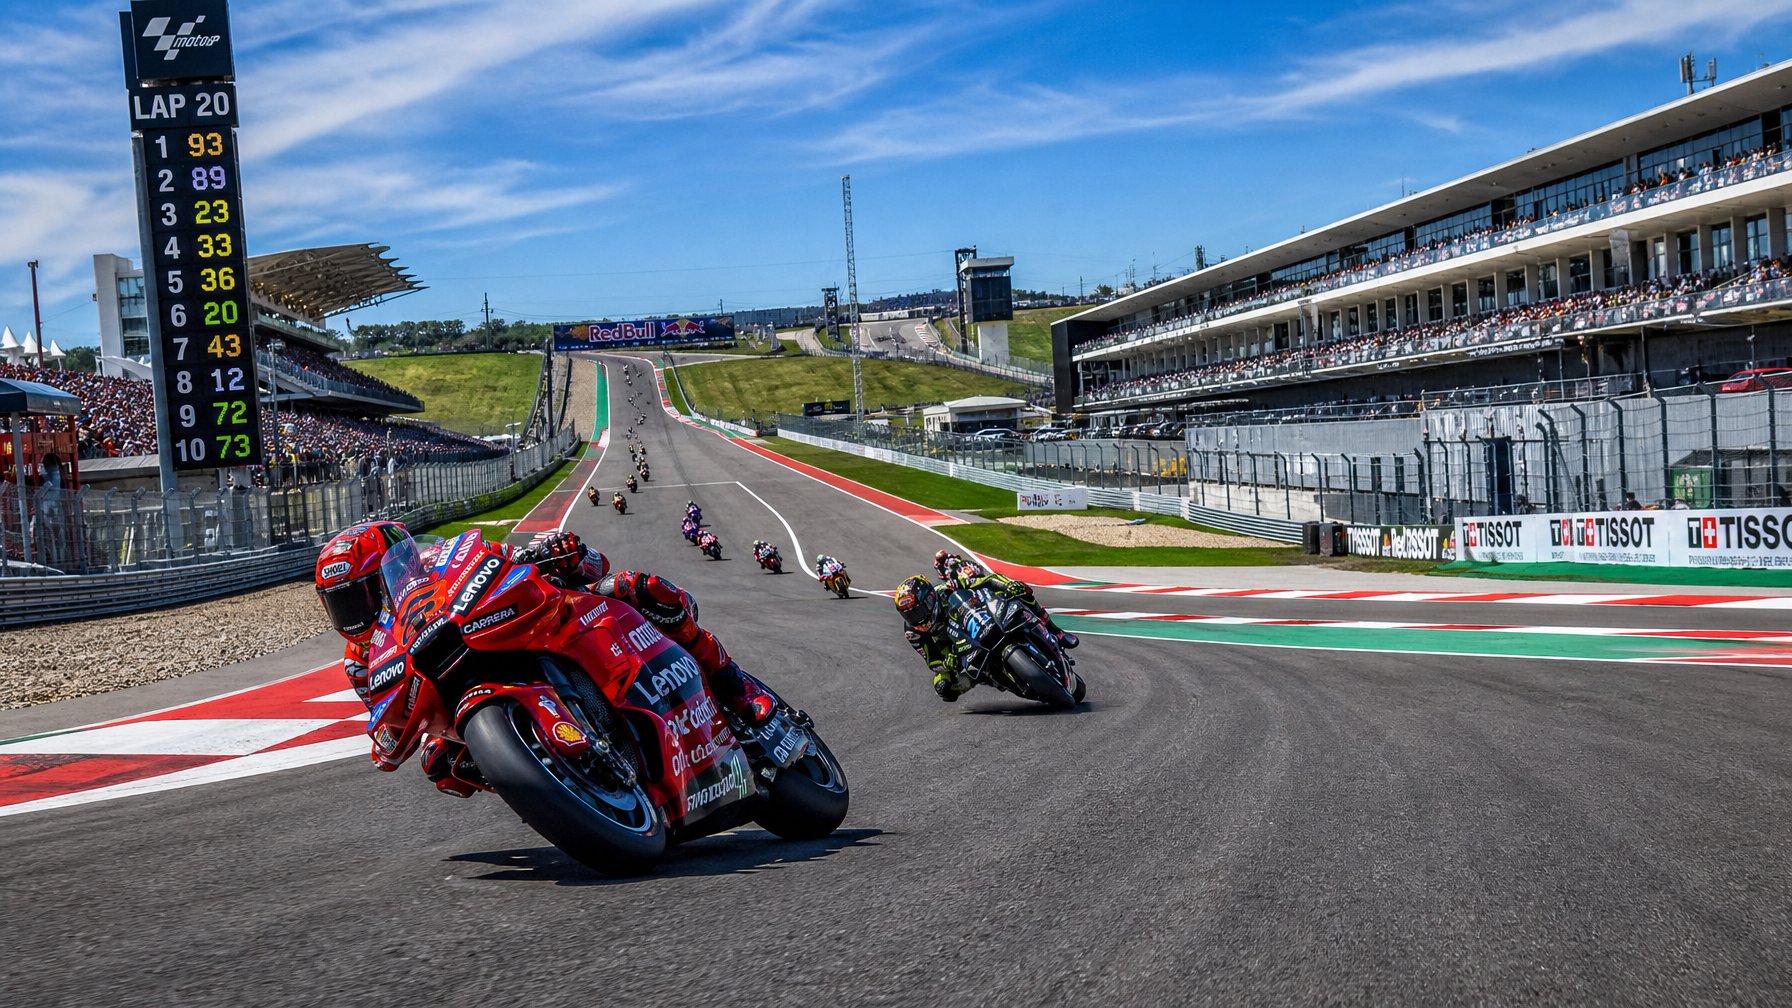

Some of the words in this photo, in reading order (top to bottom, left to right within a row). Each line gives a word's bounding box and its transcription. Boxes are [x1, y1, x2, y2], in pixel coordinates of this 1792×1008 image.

[134, 94, 186, 120] LAP
[196, 92, 230, 116] 20
[156, 136, 168, 158] 1
[188, 132, 223, 157] 93
[158, 169, 174, 192] 2
[192, 166, 226, 190] 89
[161, 203, 177, 226] 3
[194, 200, 230, 224] 23
[164, 236, 180, 259] 4
[197, 234, 232, 258] 33
[168, 270, 184, 293] 5
[201, 267, 235, 292] 36
[171, 304, 187, 327] 6
[203, 300, 238, 325] 20
[589, 322, 655, 342] RedBull
[173, 338, 188, 361] 7
[208, 334, 241, 358] 43
[177, 371, 192, 394] 8
[211, 368, 244, 391] 12
[180, 404, 195, 427] 9
[213, 401, 247, 425] 72
[176, 438, 205, 462] 10
[216, 434, 250, 459] 73
[1477, 521, 1522, 547] TISSOT
[1596, 517, 1654, 548] TISSOT
[454, 559, 500, 611] Lenovo
[370, 662, 404, 691] Lenovo
[634, 656, 699, 705] Lenovo
